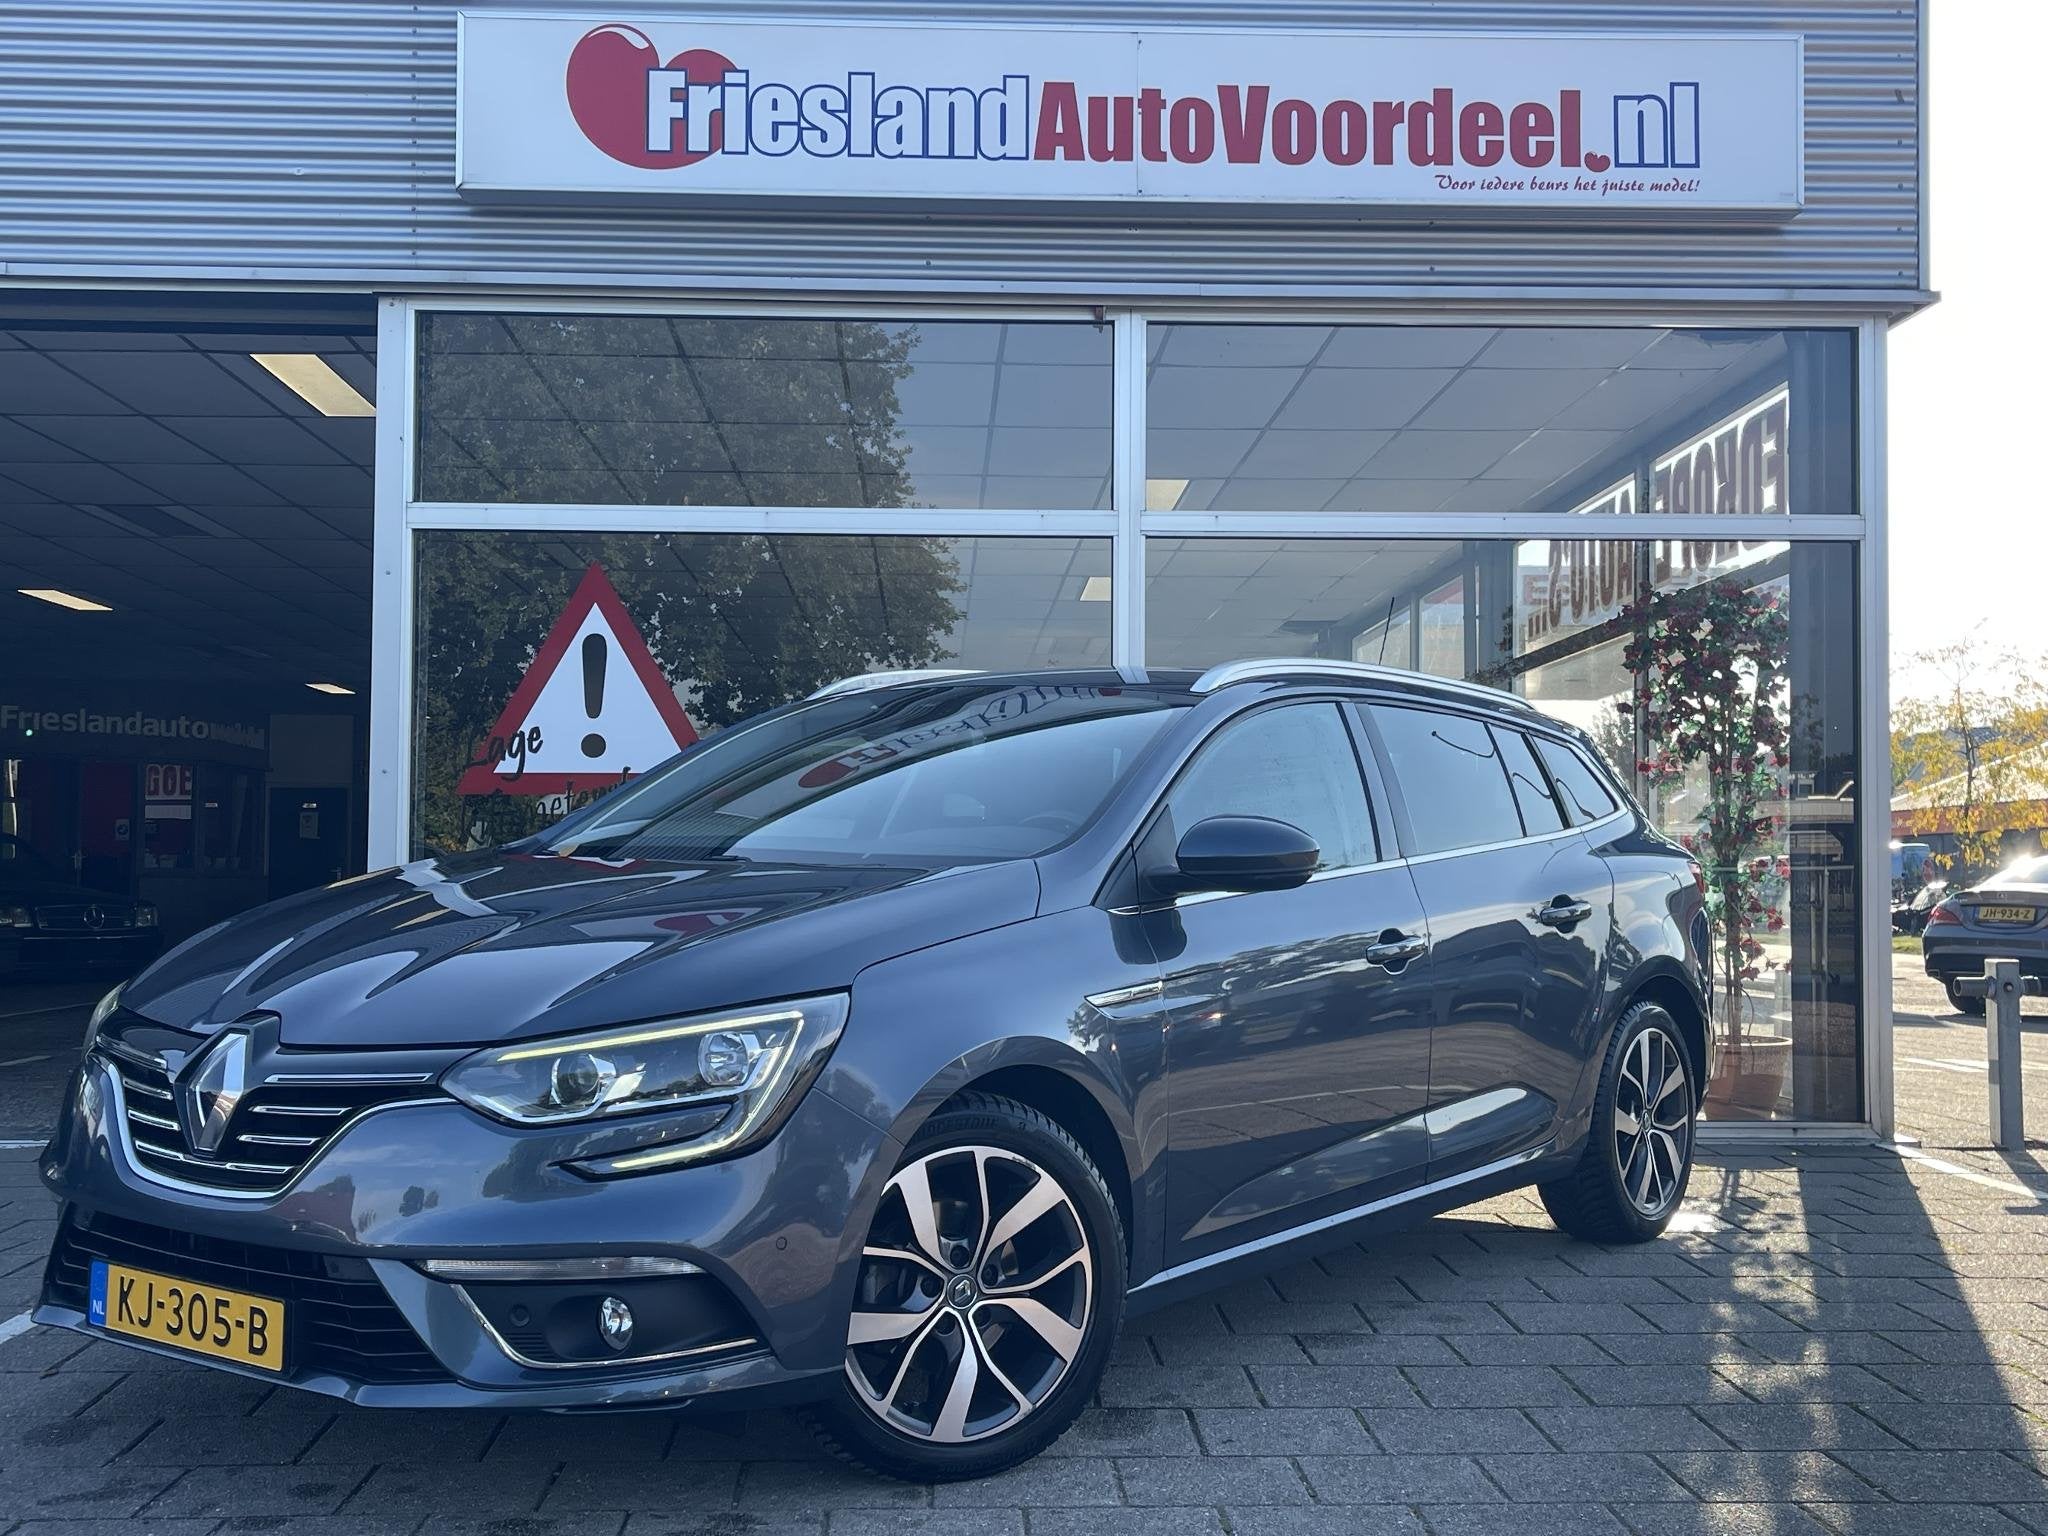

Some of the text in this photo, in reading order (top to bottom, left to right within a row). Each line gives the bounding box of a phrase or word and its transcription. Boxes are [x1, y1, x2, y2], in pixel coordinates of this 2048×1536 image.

[1435, 174, 1701, 196] Voor iedere beurs het juiste model!
[1982, 908, 2032, 919] JH-934-Z
[92, 1275, 268, 1356] NL KJ-305-B
